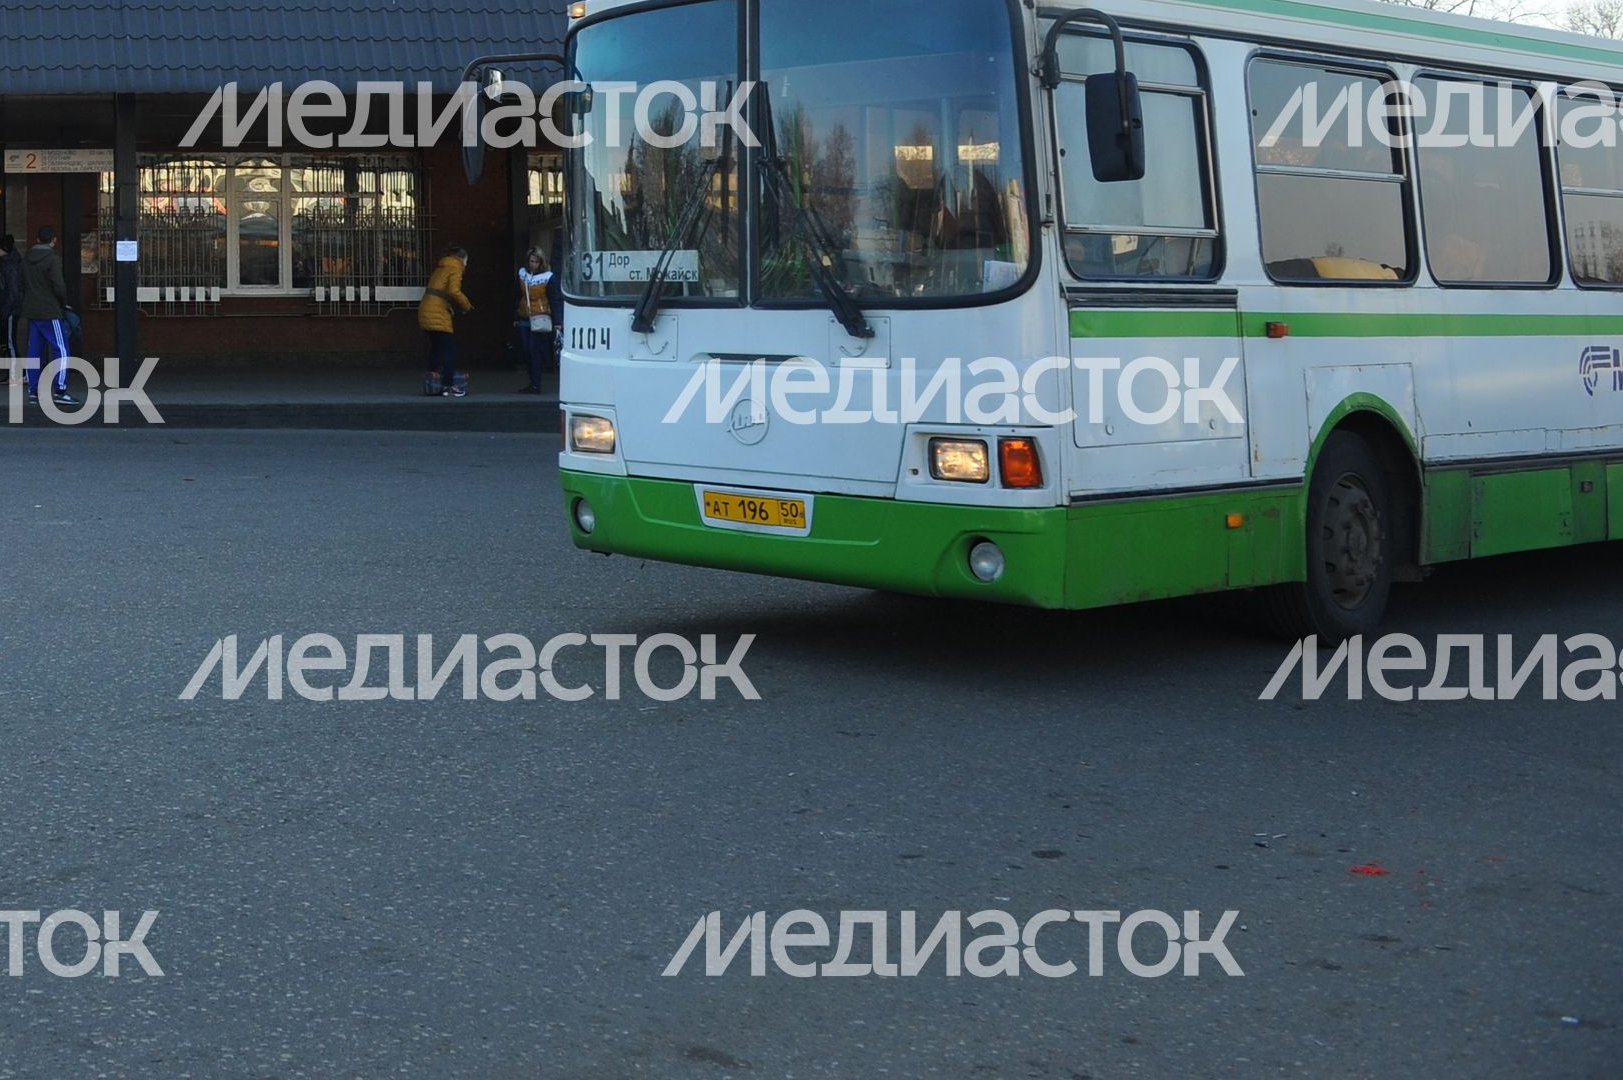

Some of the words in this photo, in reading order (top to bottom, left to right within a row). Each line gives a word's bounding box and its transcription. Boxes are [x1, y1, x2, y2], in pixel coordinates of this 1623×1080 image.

[25, 153, 37, 169] 2
[582, 252, 604, 281] 31
[609, 253, 630, 269] Дор
[629, 269, 643, 281] ст.
[571, 327, 611, 350] 1104
[738, 499, 769, 521] 196
[780, 502, 799, 518] 50
